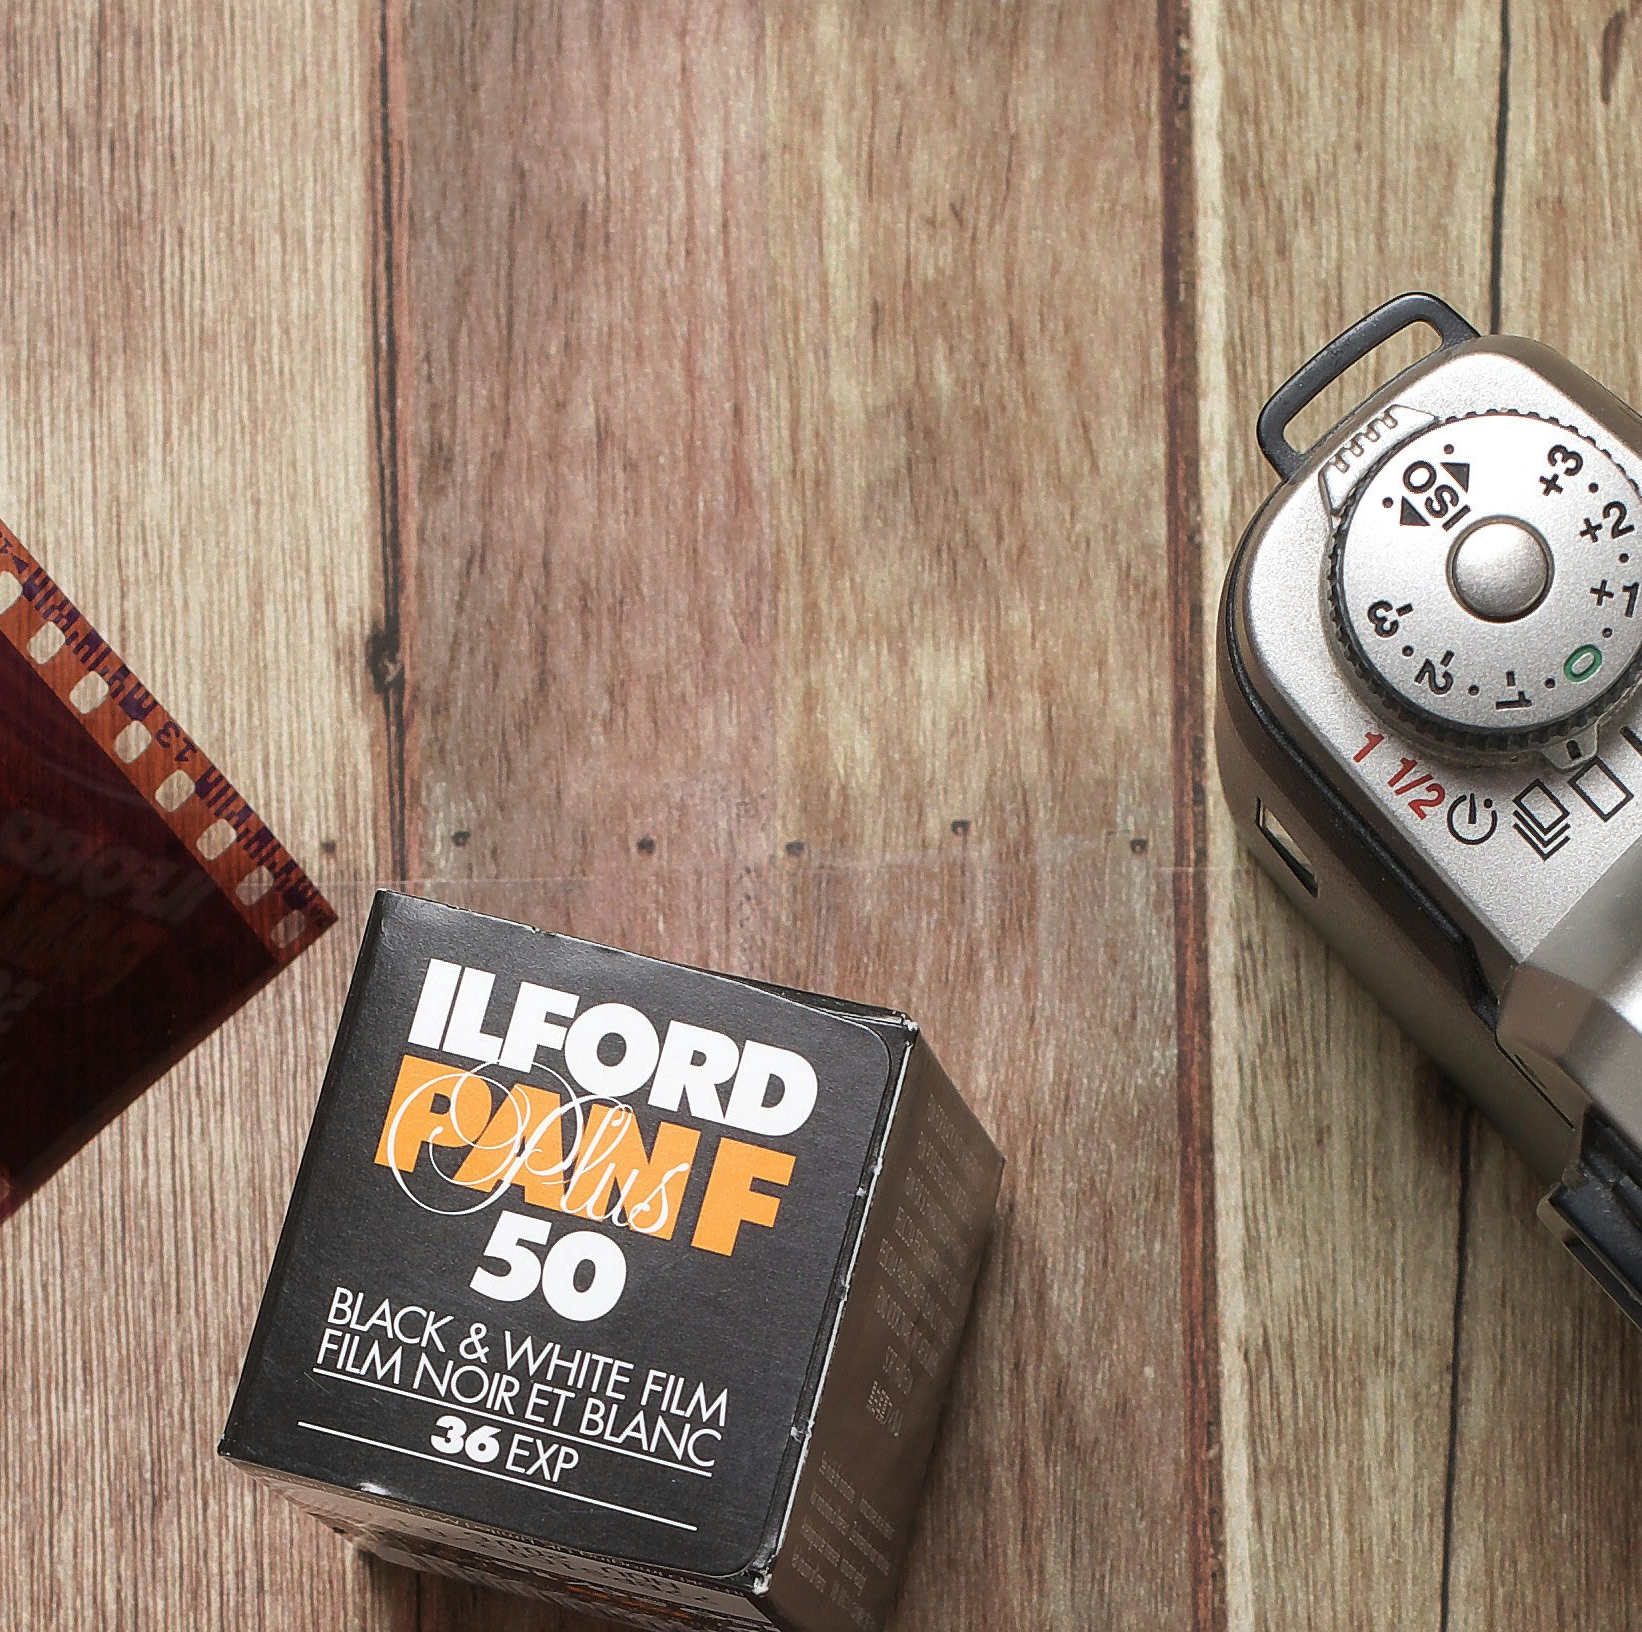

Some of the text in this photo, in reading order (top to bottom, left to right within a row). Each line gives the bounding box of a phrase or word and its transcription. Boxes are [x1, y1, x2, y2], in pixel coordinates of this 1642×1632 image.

[1403, 460, 1471, 532] ISO
[1539, 444, 1584, 497] +3
[1579, 500, 1635, 544] +2
[1367, 599, 1413, 638] -3
[1589, 579, 1640, 618] +1
[1416, 650, 1455, 695] -2
[1495, 671, 1533, 710] -1
[1564, 644, 1603, 682] 0
[154, 720, 197, 764] 13
[1387, 757, 1446, 820] 1/2
[407, 959, 818, 1138] ILFORD
[374, 1054, 700, 1241] PAN
[691, 1137, 797, 1257] F
[387, 1058, 691, 1237] Plus
[469, 1212, 628, 1322] 50
[327, 1287, 729, 1428] BLACK & WHITE FILM
[317, 1329, 724, 1470] FILM NOIR ET BLANC
[430, 1415, 580, 1485] 36 EXP
